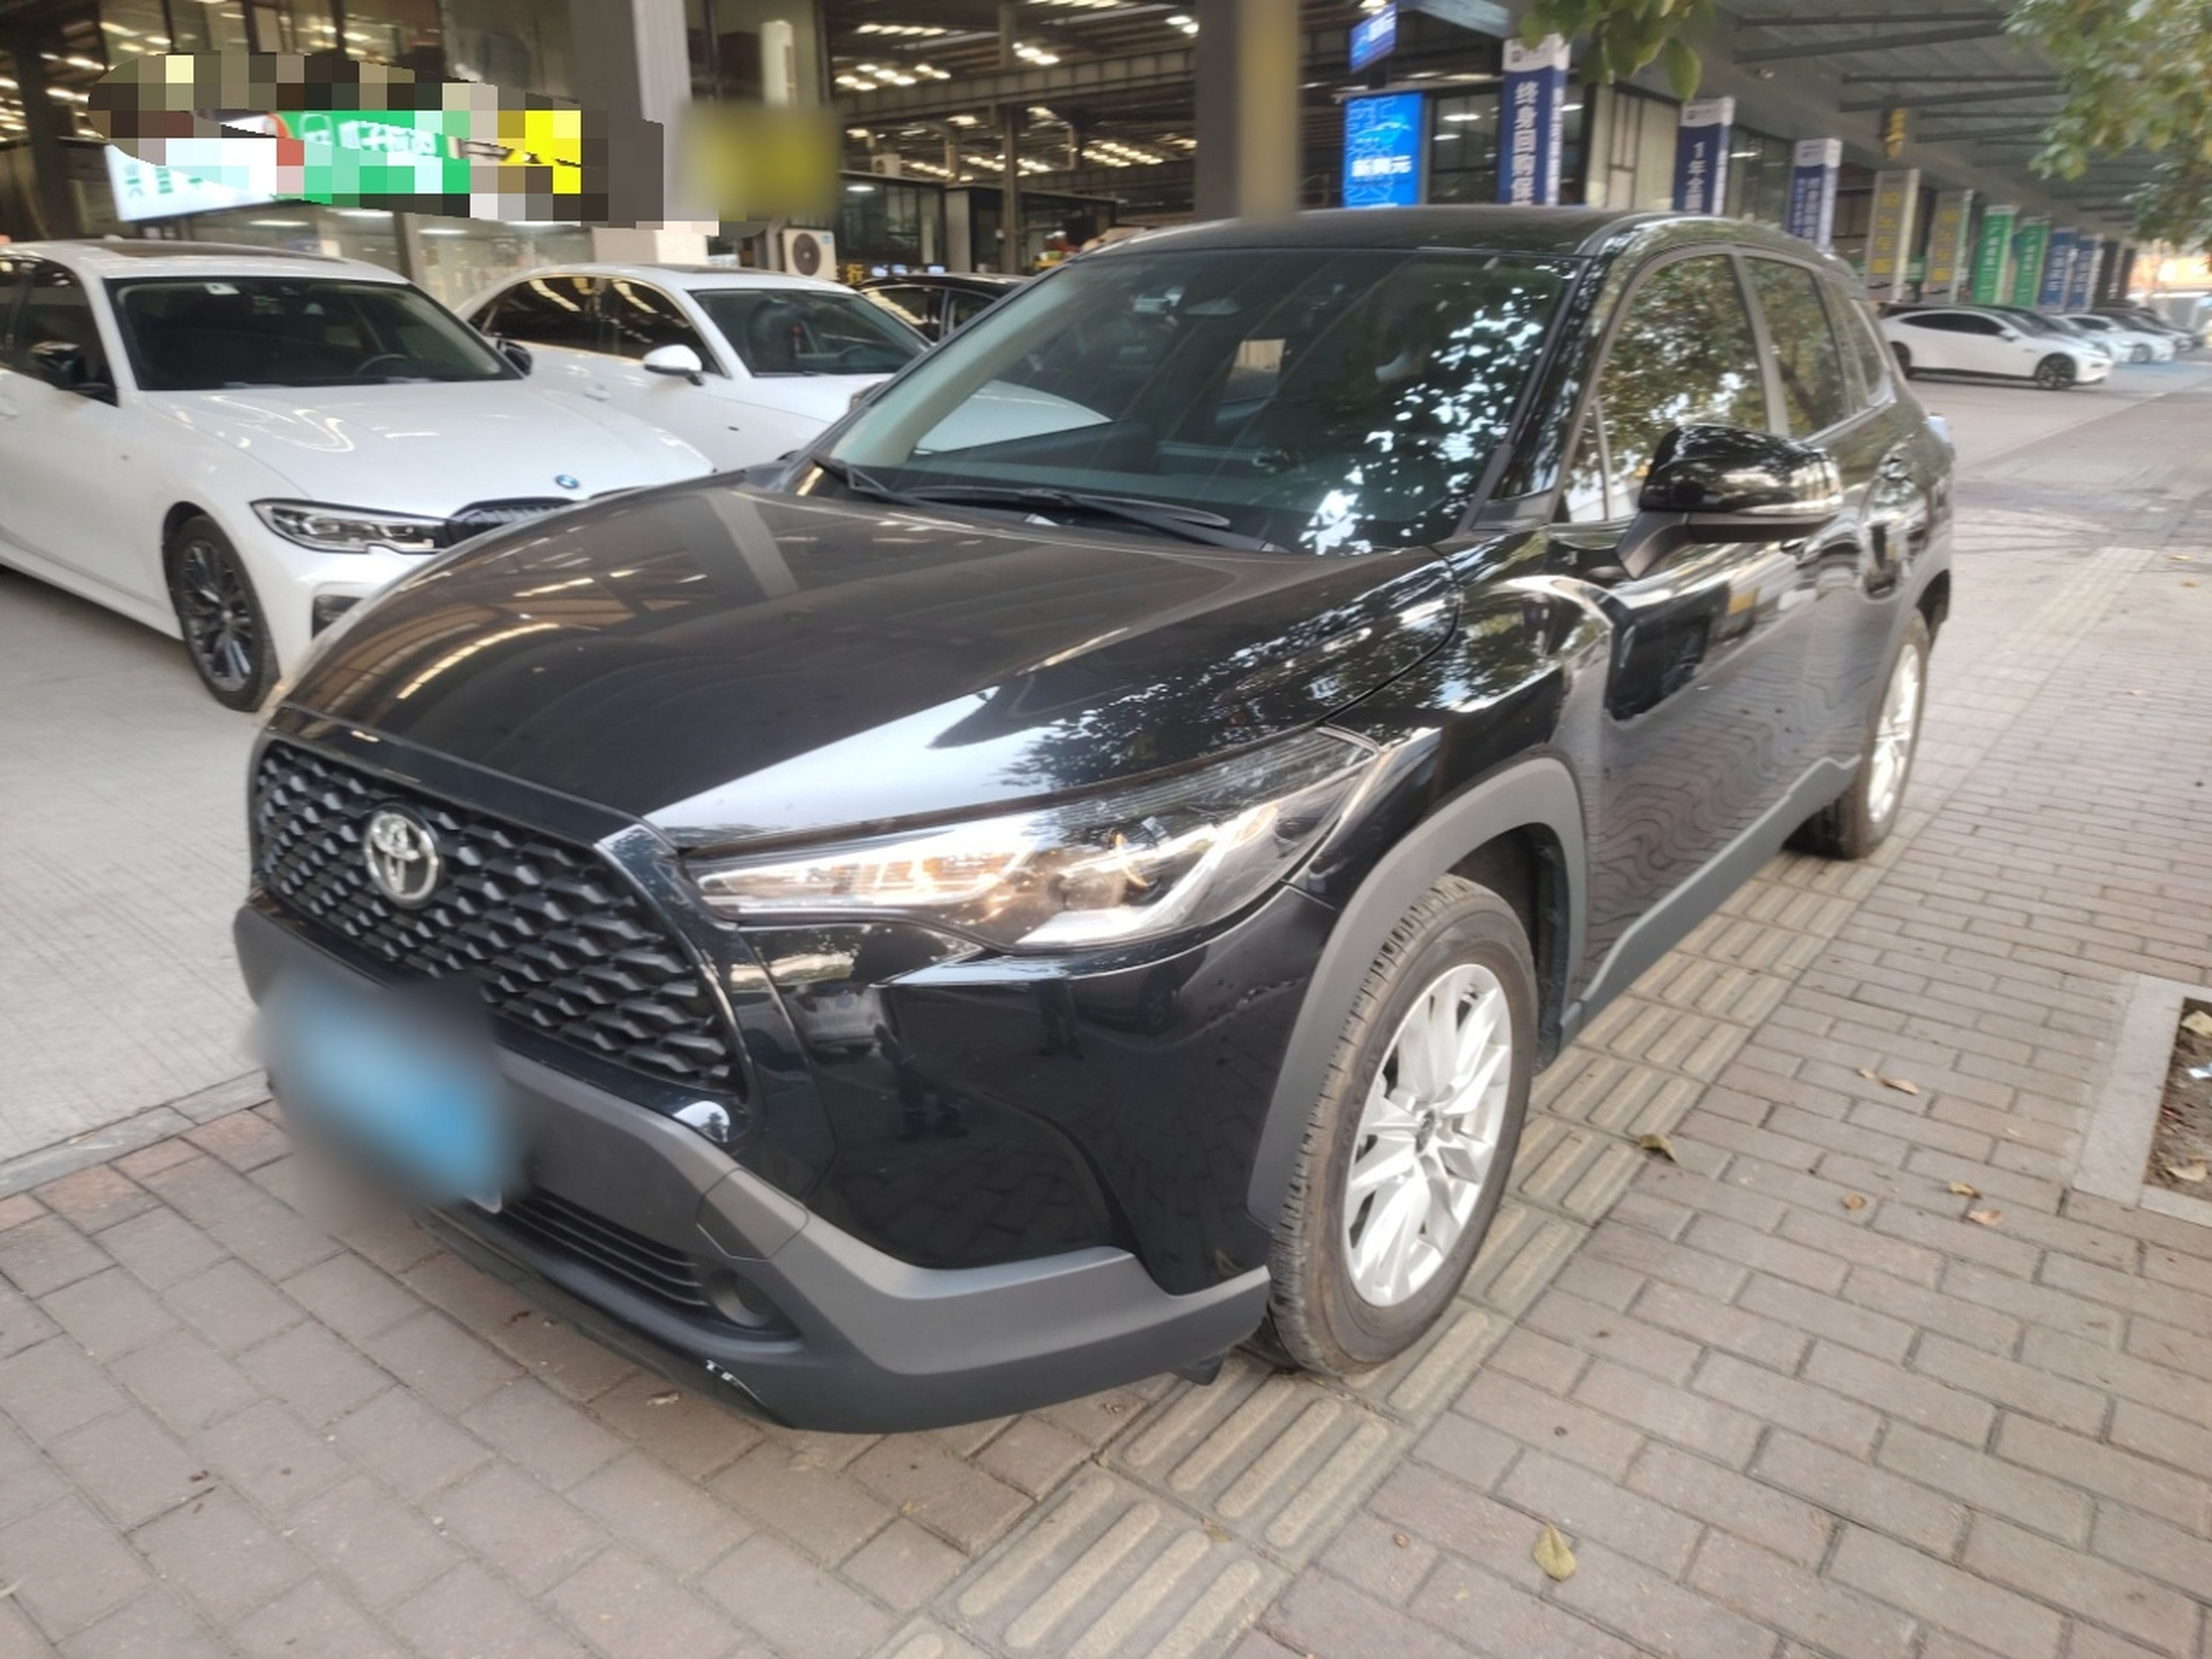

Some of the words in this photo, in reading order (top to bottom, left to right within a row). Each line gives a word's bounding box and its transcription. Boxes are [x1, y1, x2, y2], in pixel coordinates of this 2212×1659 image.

[1510, 81, 1539, 206] 终身回购保
